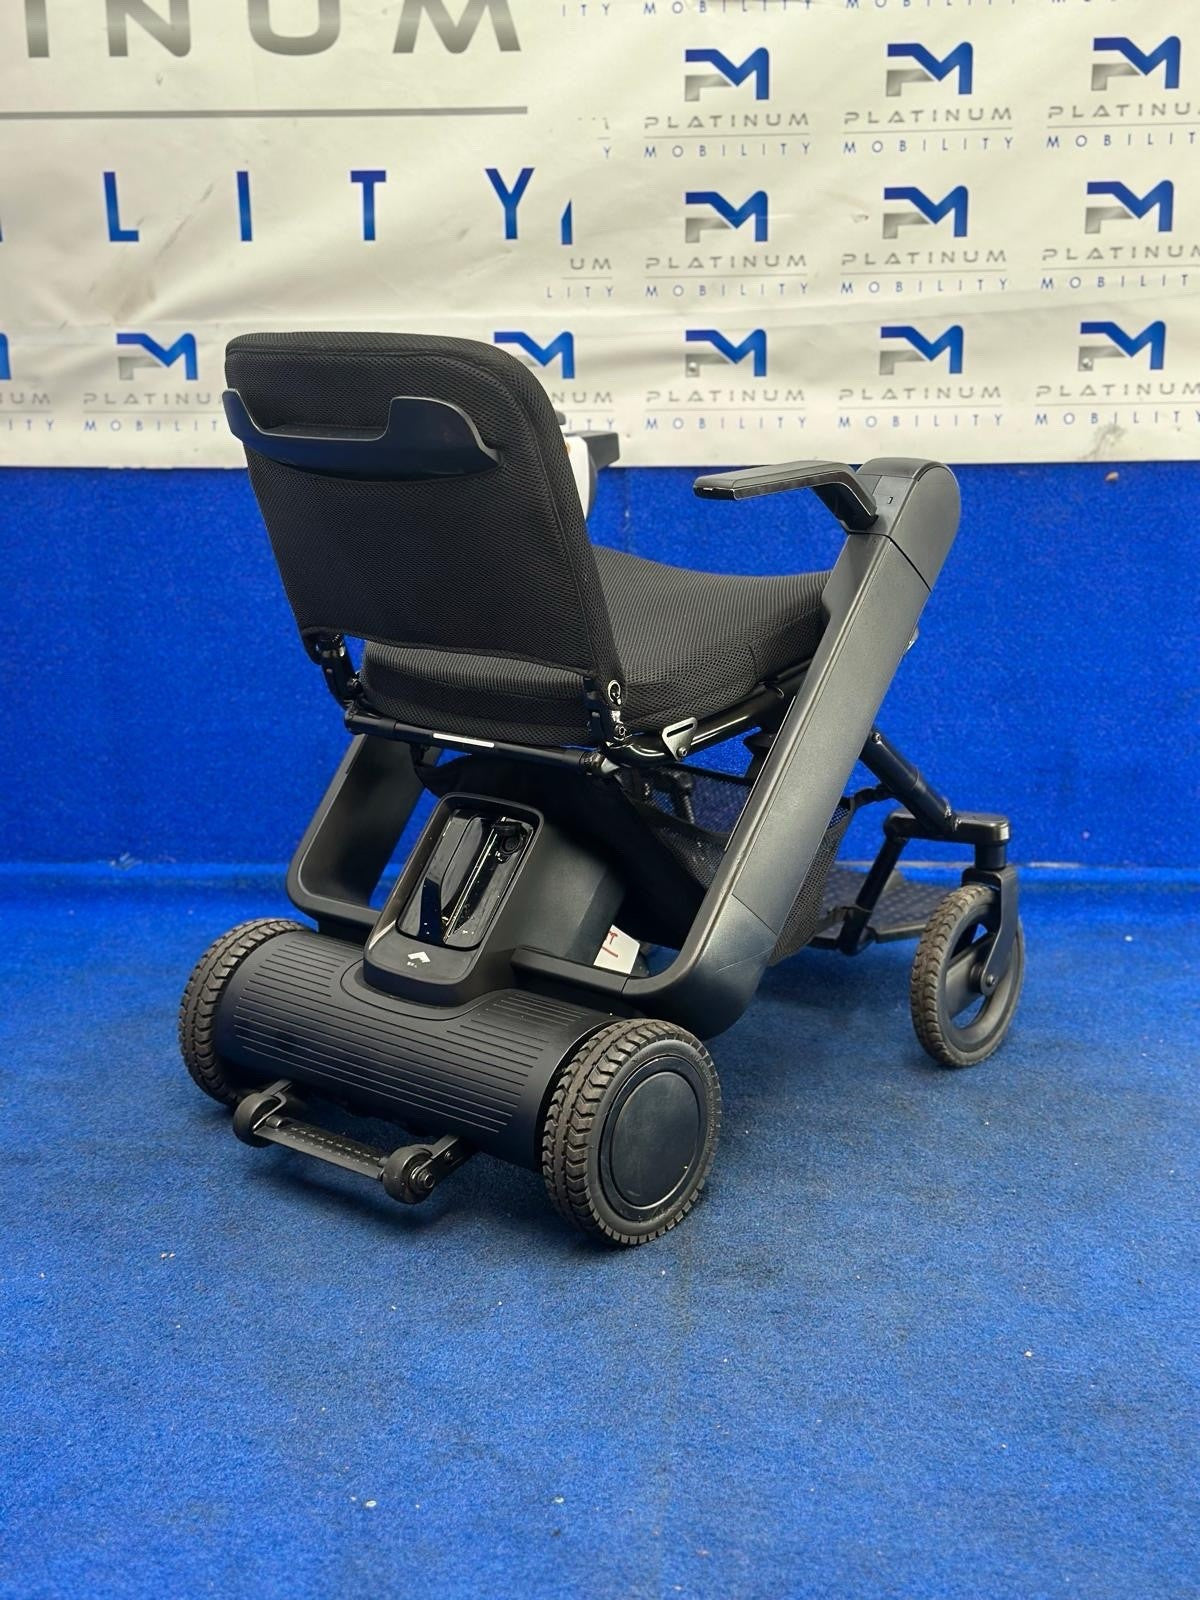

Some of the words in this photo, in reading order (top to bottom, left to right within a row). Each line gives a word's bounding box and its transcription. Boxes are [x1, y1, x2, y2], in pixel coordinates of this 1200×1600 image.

[844, 107, 1012, 125] PLATINUM
[1048, 102, 1200, 119] PLATINU
[644, 113, 809, 129] PLATINUM
[644, 142, 810, 158] MOBILITY
[843, 136, 1013, 154] MOBILITY
[0, 168, 534, 242] LITY
[645, 254, 807, 270] PLATINUM
[841, 249, 1007, 266] PLATINUM
[645, 282, 808, 297] MOBILITY
[840, 278, 1008, 294] MOBILITY
[645, 389, 806, 403] PLATINUM
[839, 386, 1002, 401] PLATINUM
[1035, 382, 1200, 398] PLATINUM
[0, 392, 51, 405] UM
[83, 392, 222, 405] PLATINU
[645, 416, 807, 431] MOBILITY
[838, 414, 1003, 428] MOBILITY
